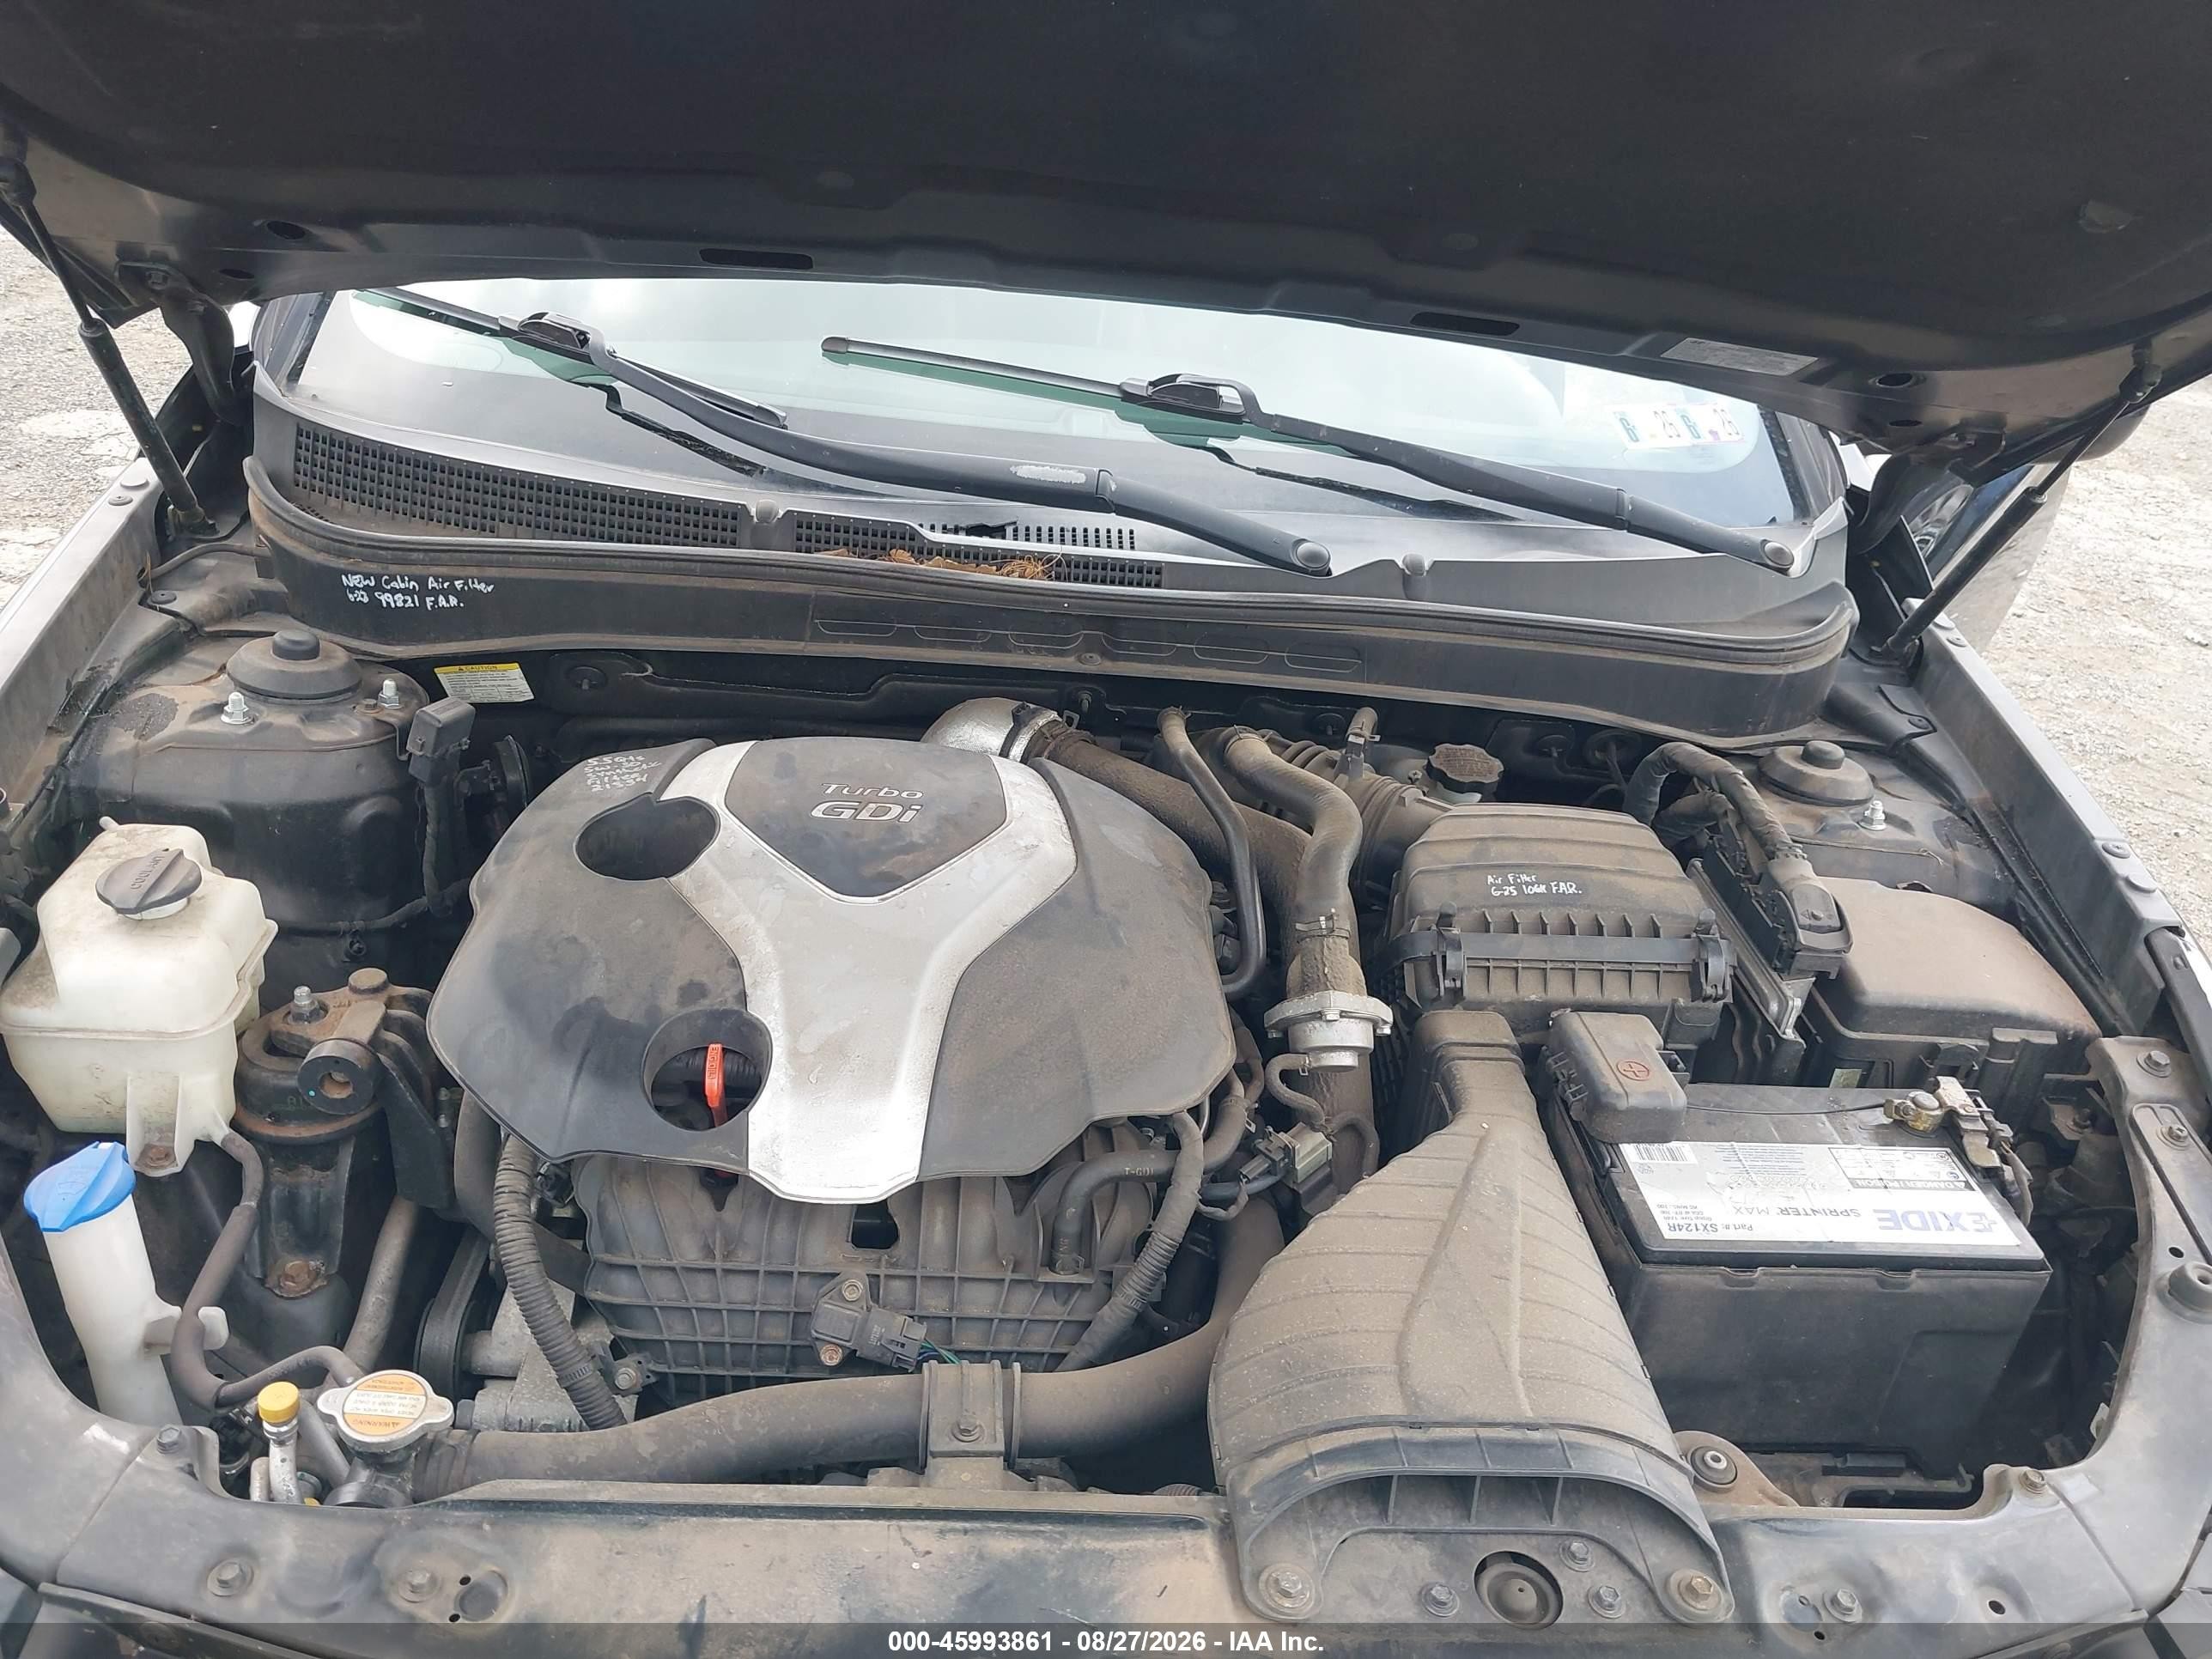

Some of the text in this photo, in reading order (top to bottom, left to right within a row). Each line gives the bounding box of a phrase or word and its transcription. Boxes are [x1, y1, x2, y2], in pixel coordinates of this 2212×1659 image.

[342, 574, 495, 594] NEW Cabin Air Filter
[374, 591, 420, 608] 99821
[822, 783, 924, 799] Turbo
[810, 799, 923, 823] GDi
[1487, 872, 1537, 885] Air Filter
[1856, 1179, 1900, 1188] POSON
[1668, 1222, 1718, 1233] SX124R
[1734, 1206, 1998, 1233] EXIDE SPRINTER MAX
[1734, 1224, 1753, 1232] Part
